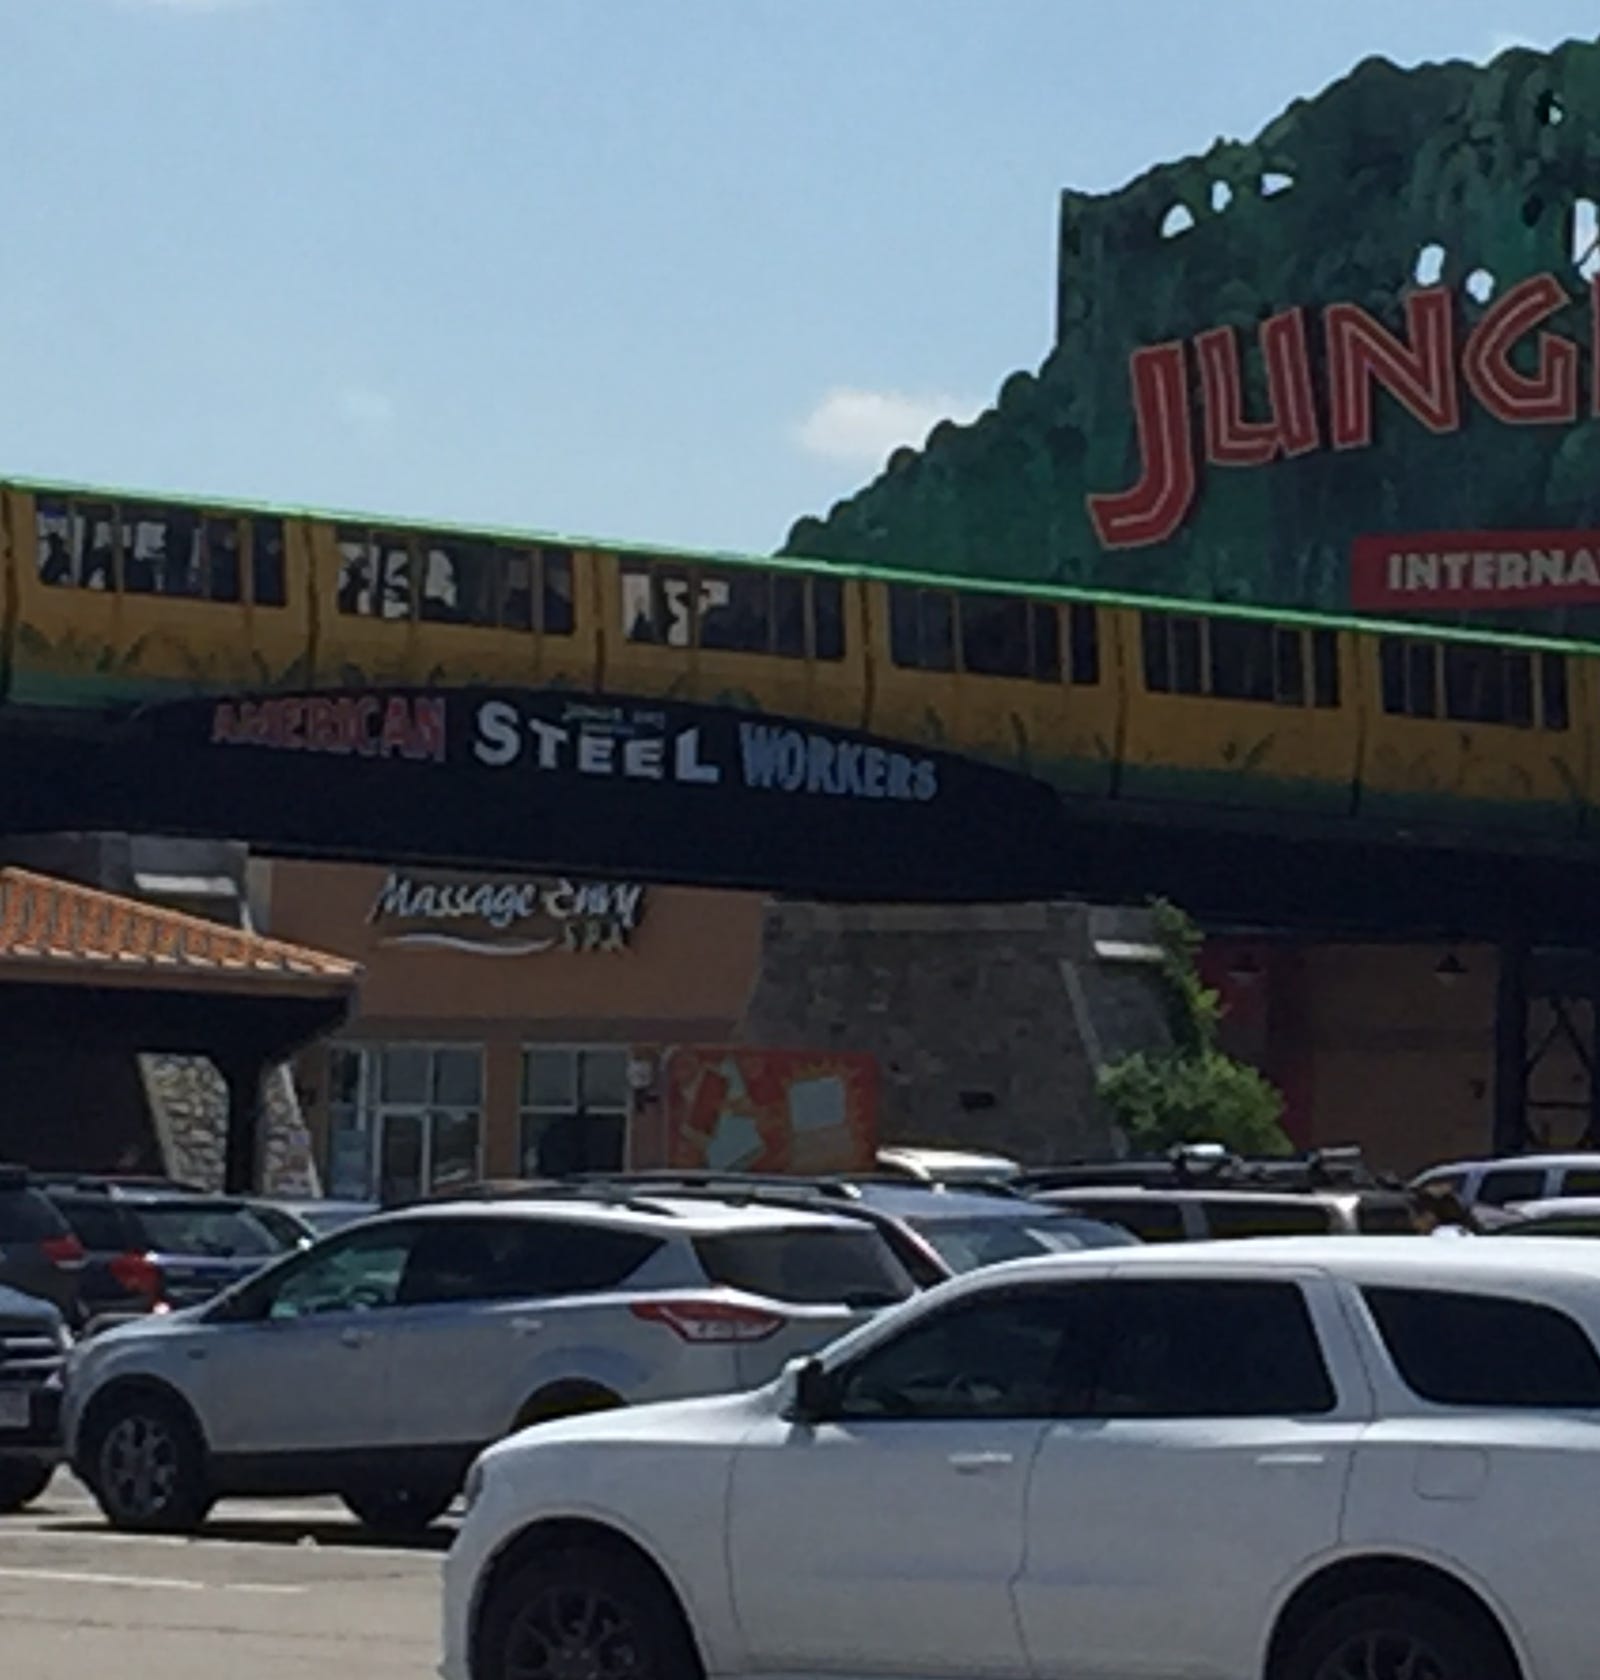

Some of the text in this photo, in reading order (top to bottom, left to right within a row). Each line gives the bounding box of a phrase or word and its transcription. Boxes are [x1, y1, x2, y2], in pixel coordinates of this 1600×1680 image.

[210, 696, 447, 763] AMERICAN
[474, 701, 720, 782] STEEL
[739, 722, 938, 801] WORKERS
[364, 872, 538, 928] Massage
